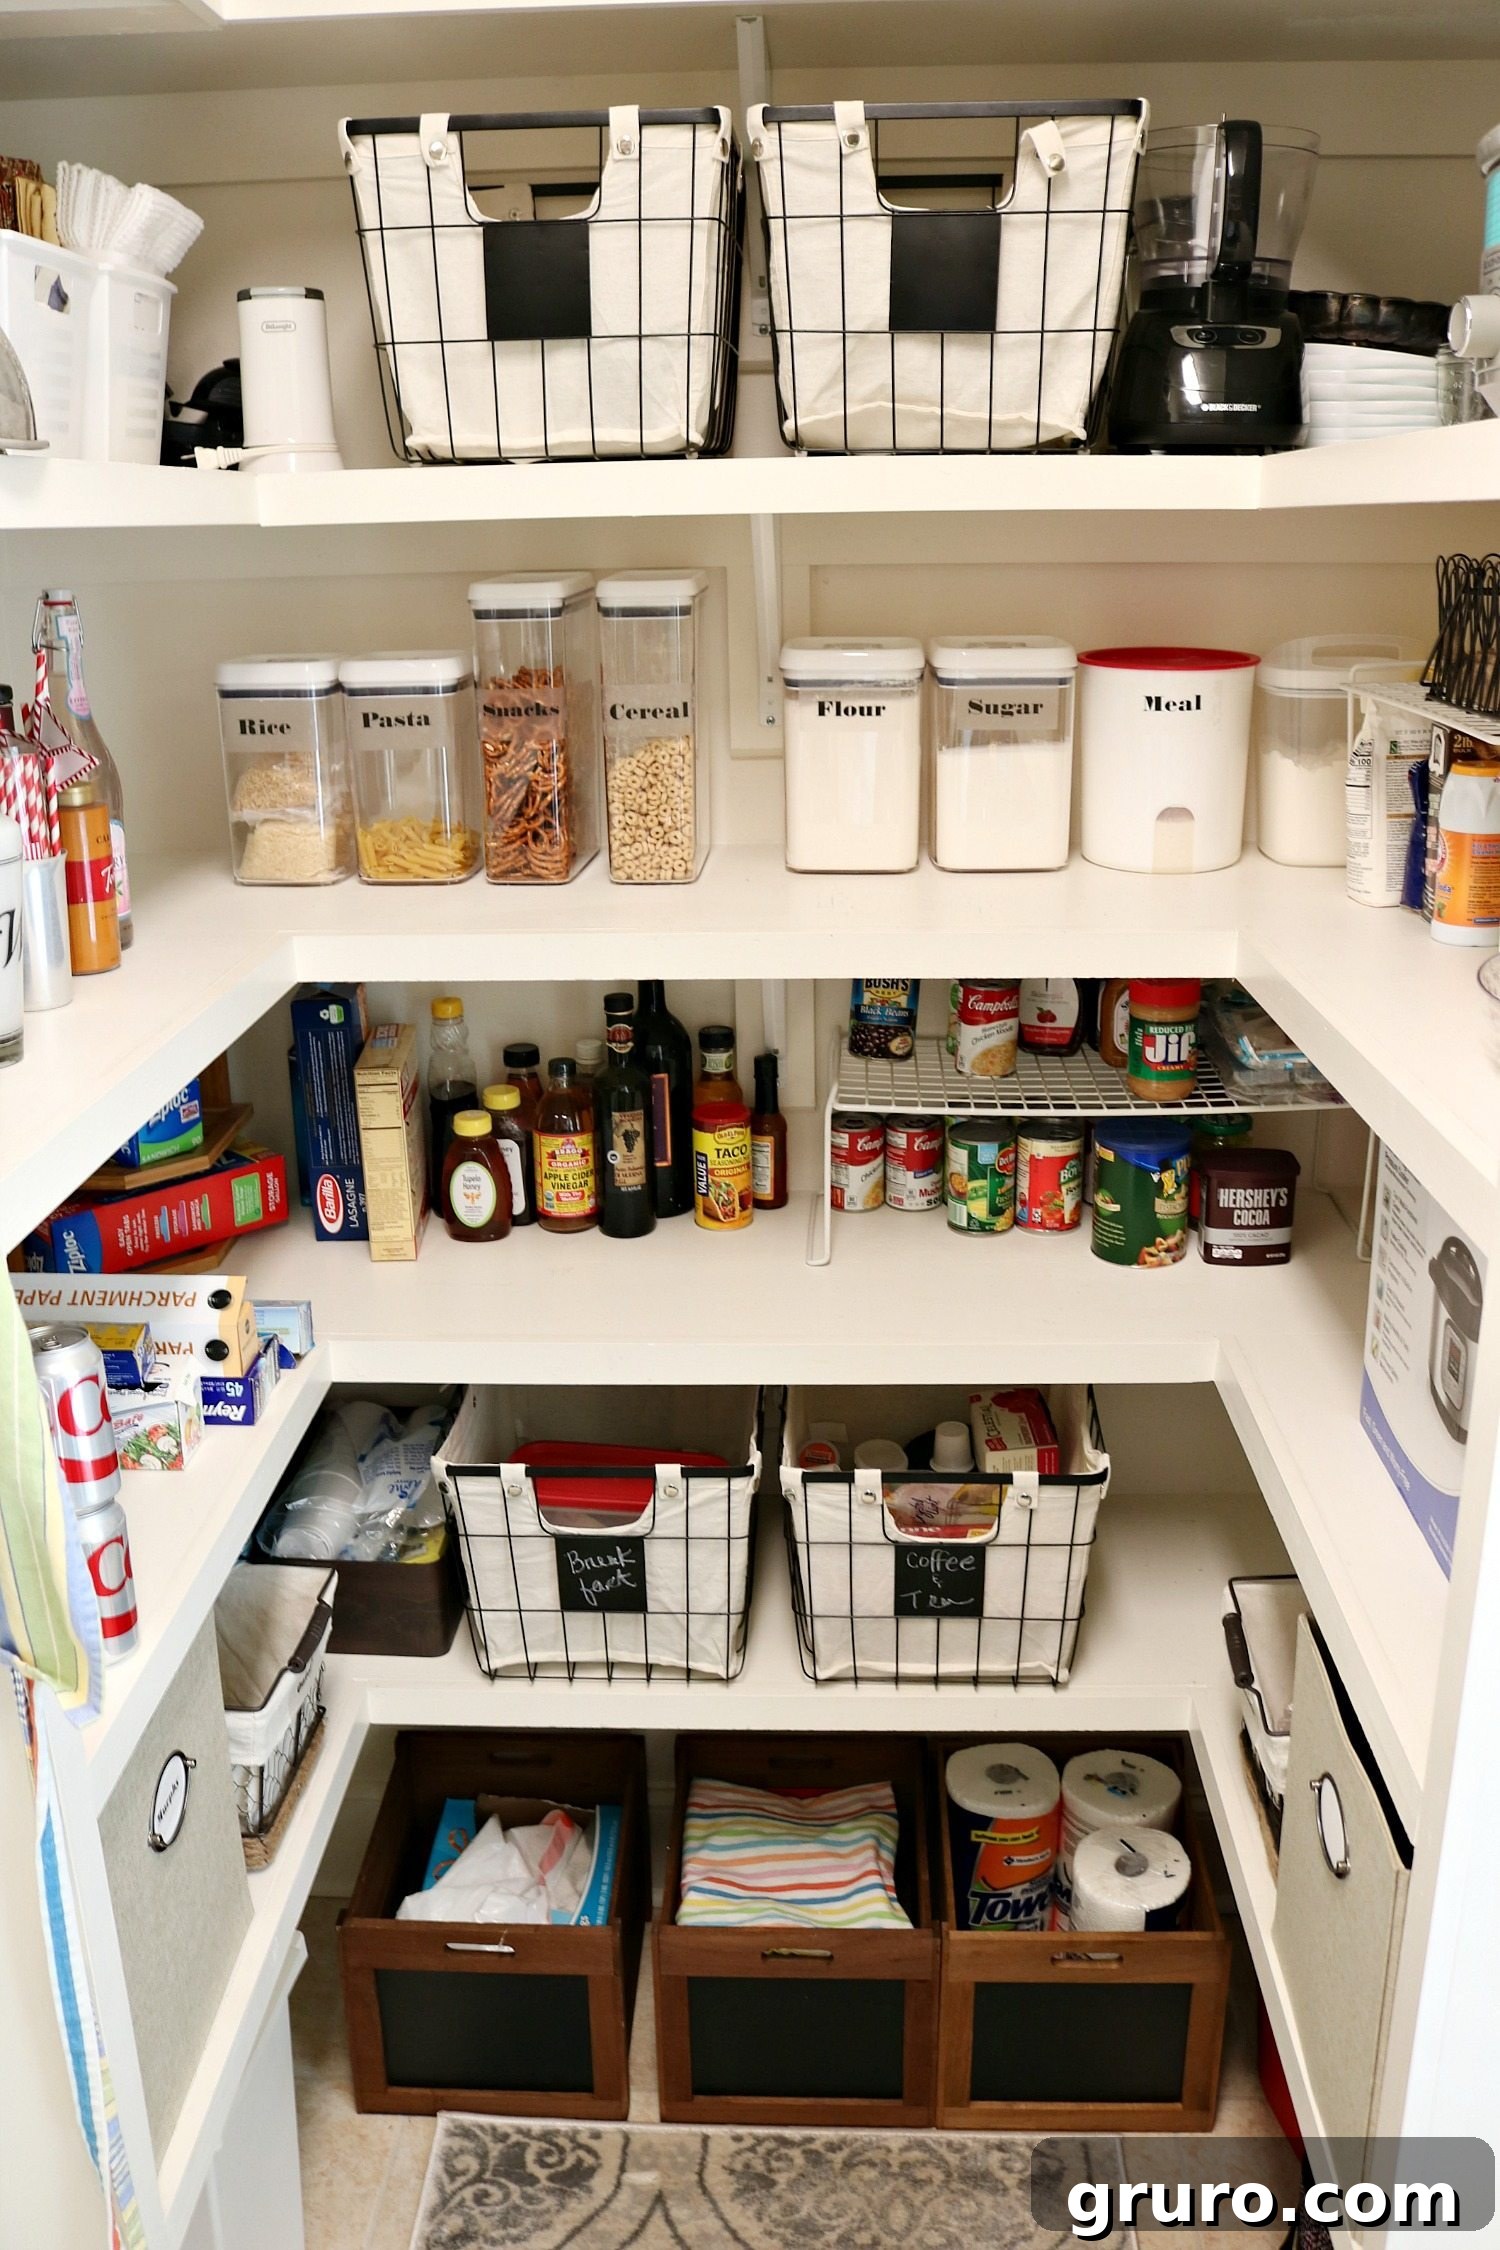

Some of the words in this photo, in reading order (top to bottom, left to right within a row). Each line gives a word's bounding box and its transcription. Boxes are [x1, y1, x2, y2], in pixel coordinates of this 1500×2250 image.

[482, 702, 560, 717] Snacks
[609, 701, 689, 720] Cereal
[817, 700, 887, 717] Flour
[967, 699, 1044, 718] Sugar
[1143, 694, 1202, 712] Meal
[239, 719, 291, 736] Rice
[361, 711, 431, 728] Pasta
[865, 978, 909, 991] BUSH'S
[1149, 1025, 1184, 1034] REDUCED
[1144, 1031, 1197, 1063] Jif
[141, 1144, 180, 1162] SANDWICH
[715, 1144, 748, 1159] TACO
[551, 1159, 586, 1167] ORGANIC
[714, 1164, 748, 1176] ORIGINAL
[544, 1171, 569, 1181] APPLE
[571, 1168, 594, 1180] CIDER
[696, 1161, 708, 1194] VALUE
[266, 1171, 276, 1212] STORAGE
[462, 1182, 481, 1191] Honey
[551, 1179, 589, 1190] VINEGAR
[324, 1178, 337, 1221] Barilla
[344, 1177, 359, 1228] LASAGNE
[1218, 1187, 1289, 1208] HERSHEY'S
[1232, 1209, 1270, 1226] COCOA
[63, 1230, 88, 1274] Ziploc
[67, 1289, 197, 1308] PARCHMENT
[226, 1381, 244, 1397] 45
[203, 1401, 247, 1422] Reyn
[906, 1548, 976, 1573] Coffee
